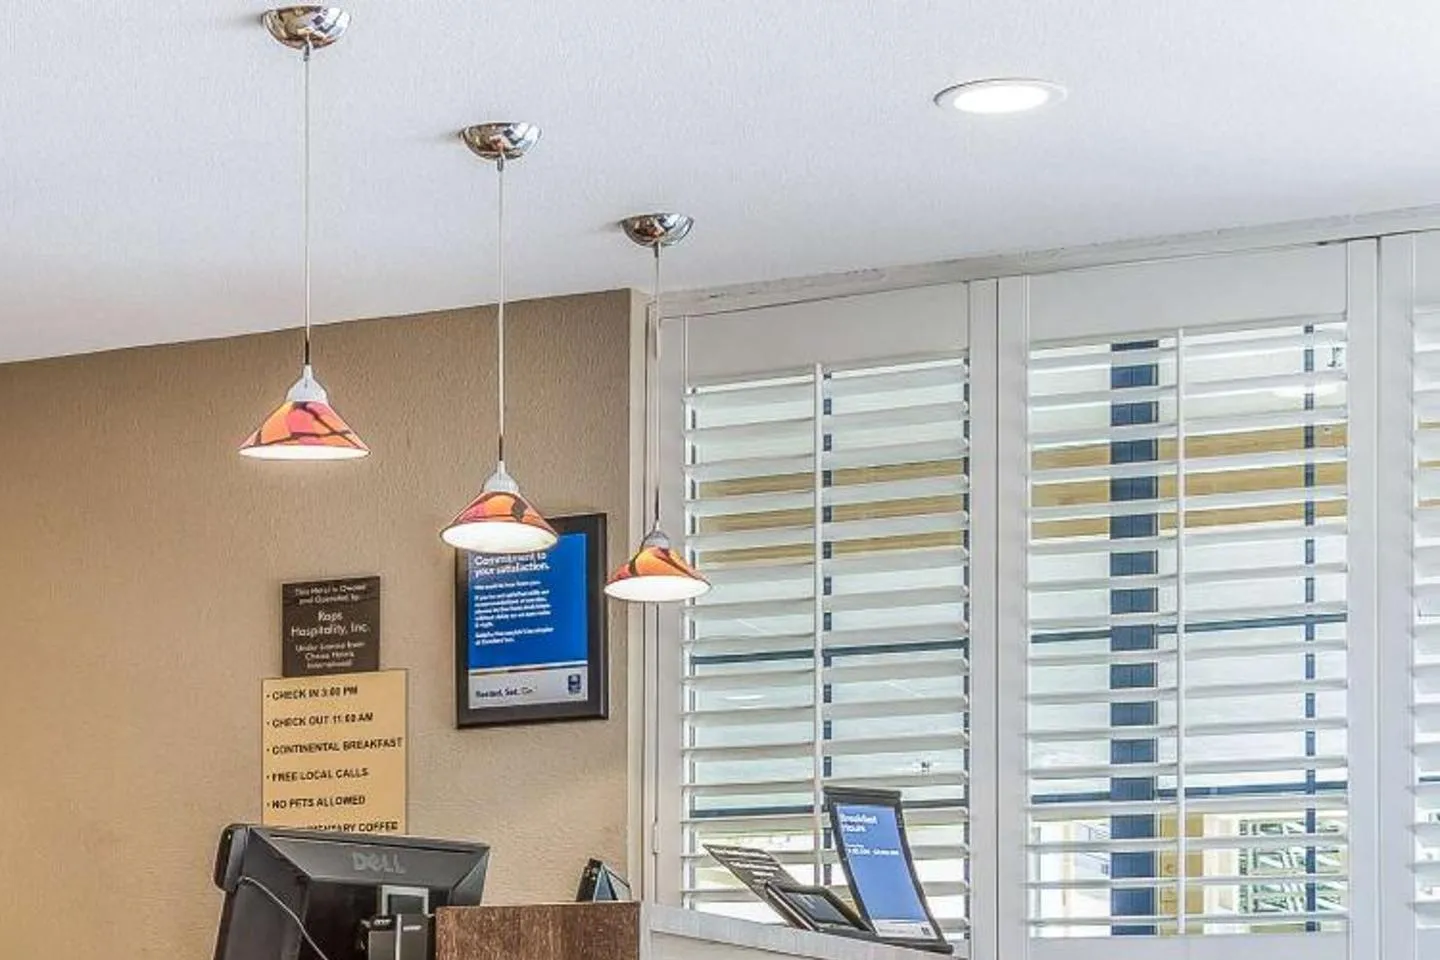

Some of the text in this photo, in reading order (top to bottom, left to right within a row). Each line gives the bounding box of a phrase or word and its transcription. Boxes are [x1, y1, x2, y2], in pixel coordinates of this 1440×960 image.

[272, 688, 306, 700] CHECK
[308, 687, 319, 698] IN
[343, 685, 358, 696] PM
[272, 716, 306, 728] CHECK
[308, 714, 329, 725] OUT
[358, 712, 374, 721] AM
[272, 737, 403, 756] CONTINENTAL BREAKFAST
[272, 767, 369, 782] FREE LOCAL CALLS
[272, 795, 366, 809] NO PETS ALLOWED
[358, 821, 398, 832] COFFEE
[353, 852, 405, 874] DELL
